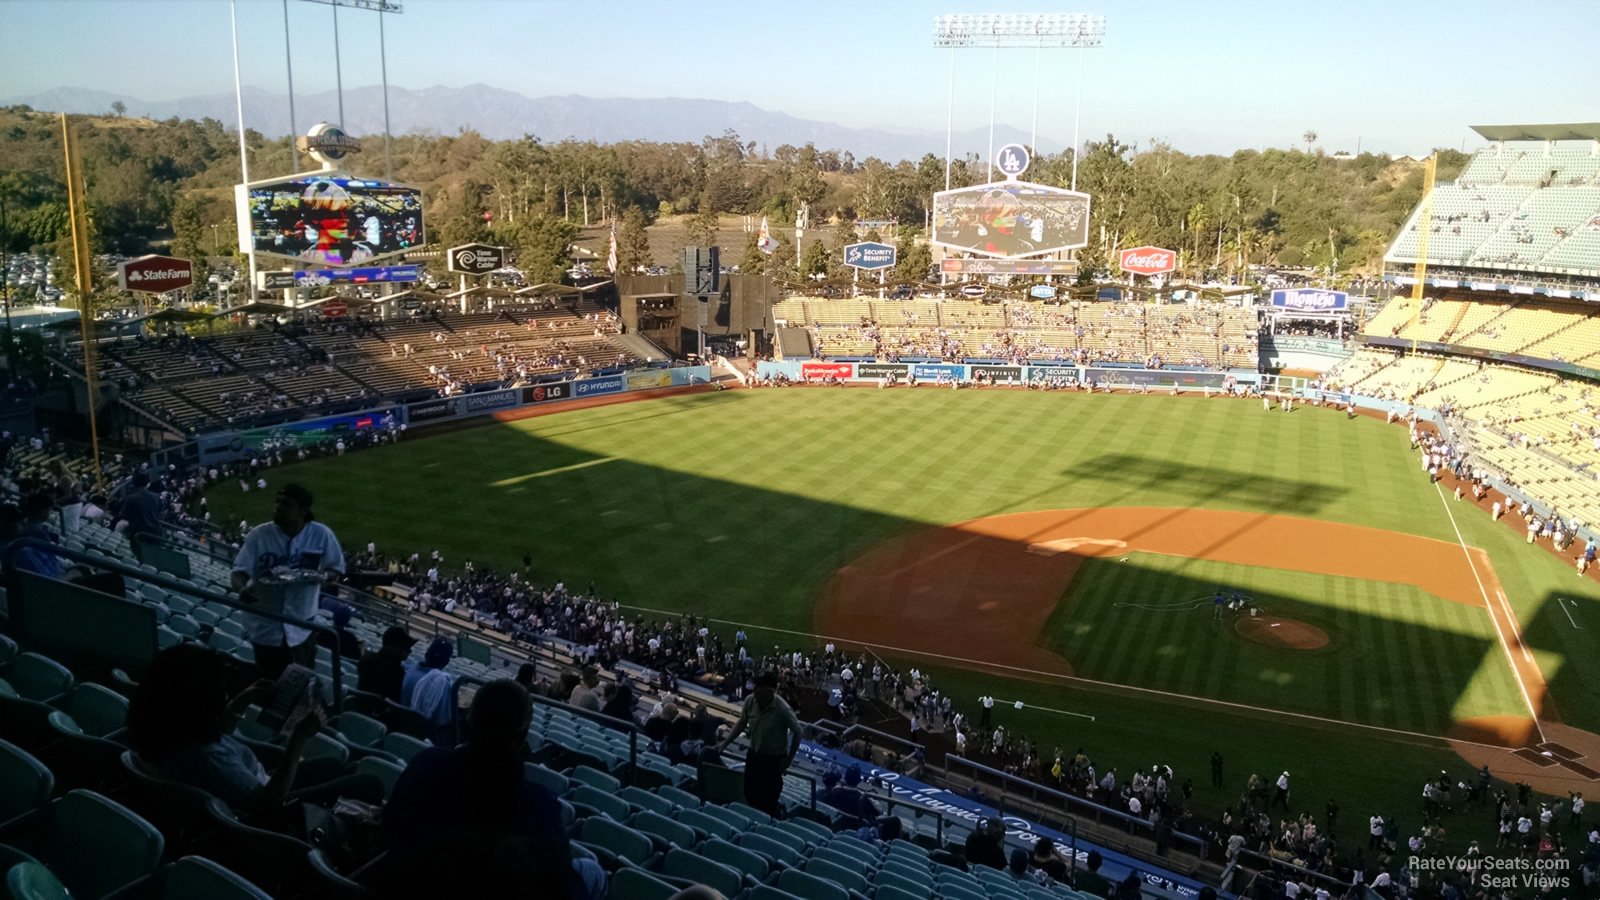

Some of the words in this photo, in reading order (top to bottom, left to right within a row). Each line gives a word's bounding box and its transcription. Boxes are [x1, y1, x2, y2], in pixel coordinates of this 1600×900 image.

[1004, 148, 1020, 171] LA
[1124, 253, 1170, 268] Coca-Cola
[590, 380, 622, 390] HYUNDAI
[547, 387, 561, 398] LG
